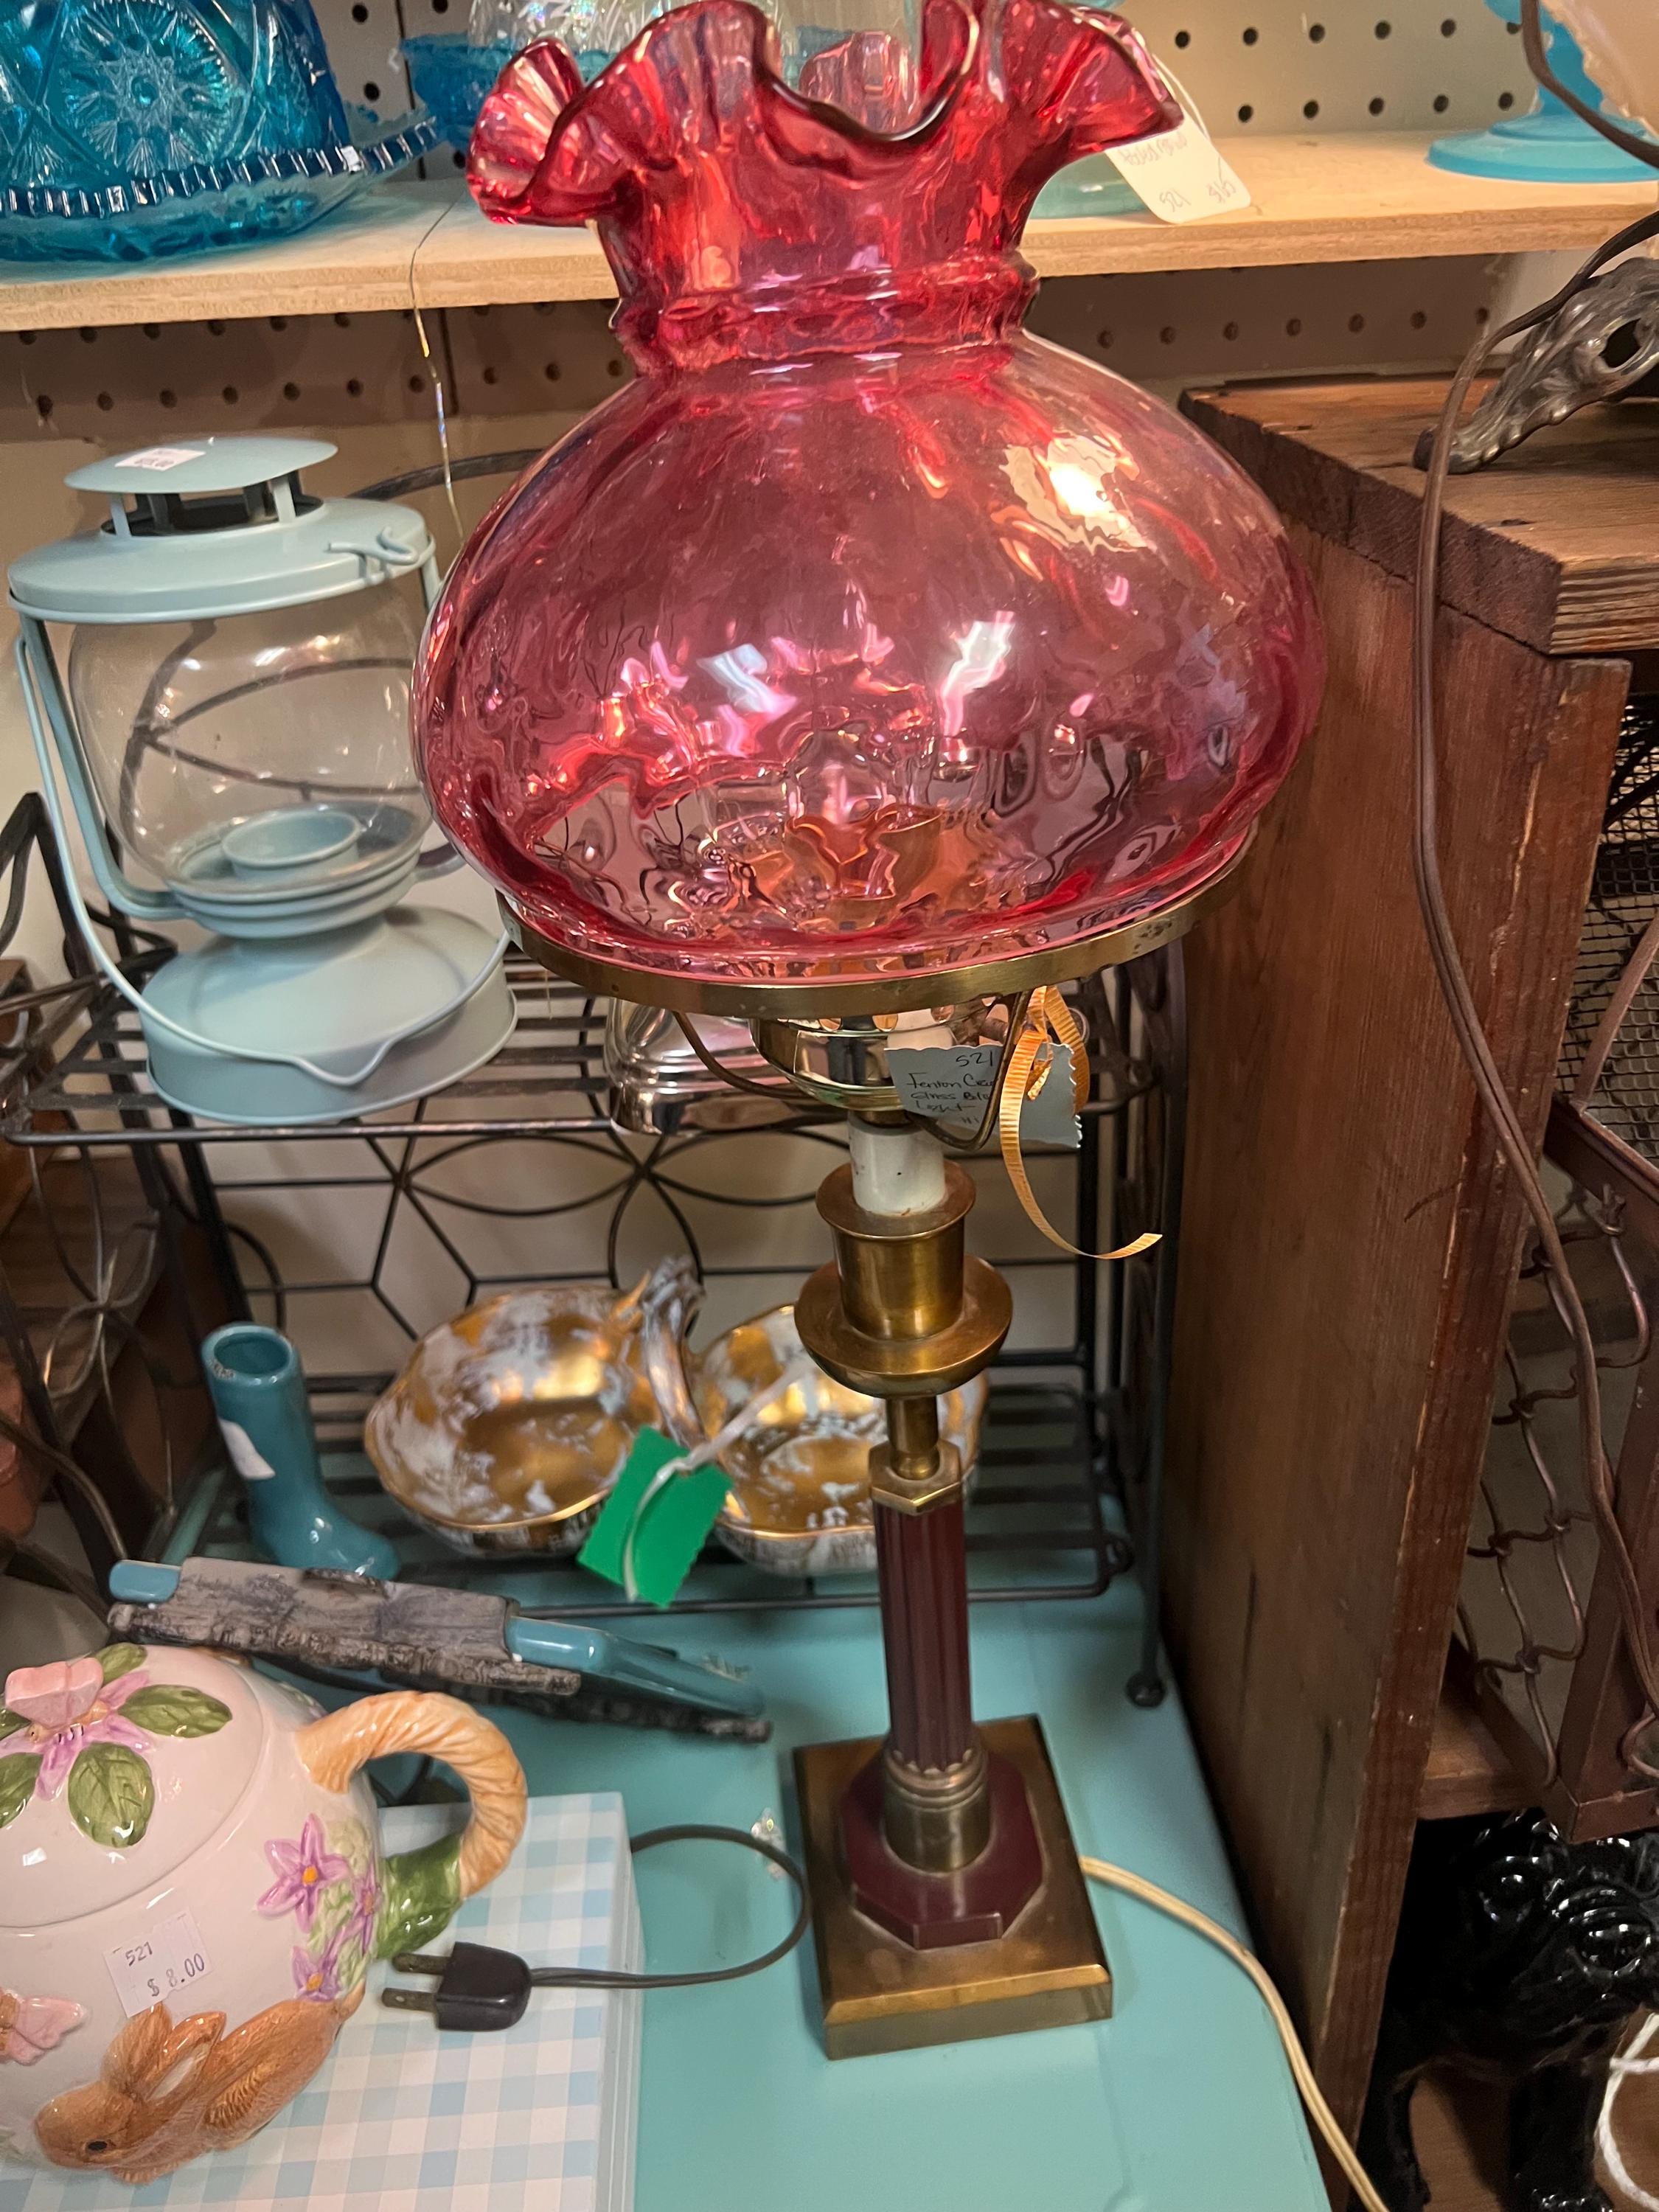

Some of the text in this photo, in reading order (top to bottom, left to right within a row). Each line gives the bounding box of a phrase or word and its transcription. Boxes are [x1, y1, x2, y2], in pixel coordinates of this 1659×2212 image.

[1160, 188, 1191, 212] 521
[956, 1051, 992, 1067] 521
[125, 1941, 153, 1966] 521
[147, 1953, 205, 1997] $ 8.00
